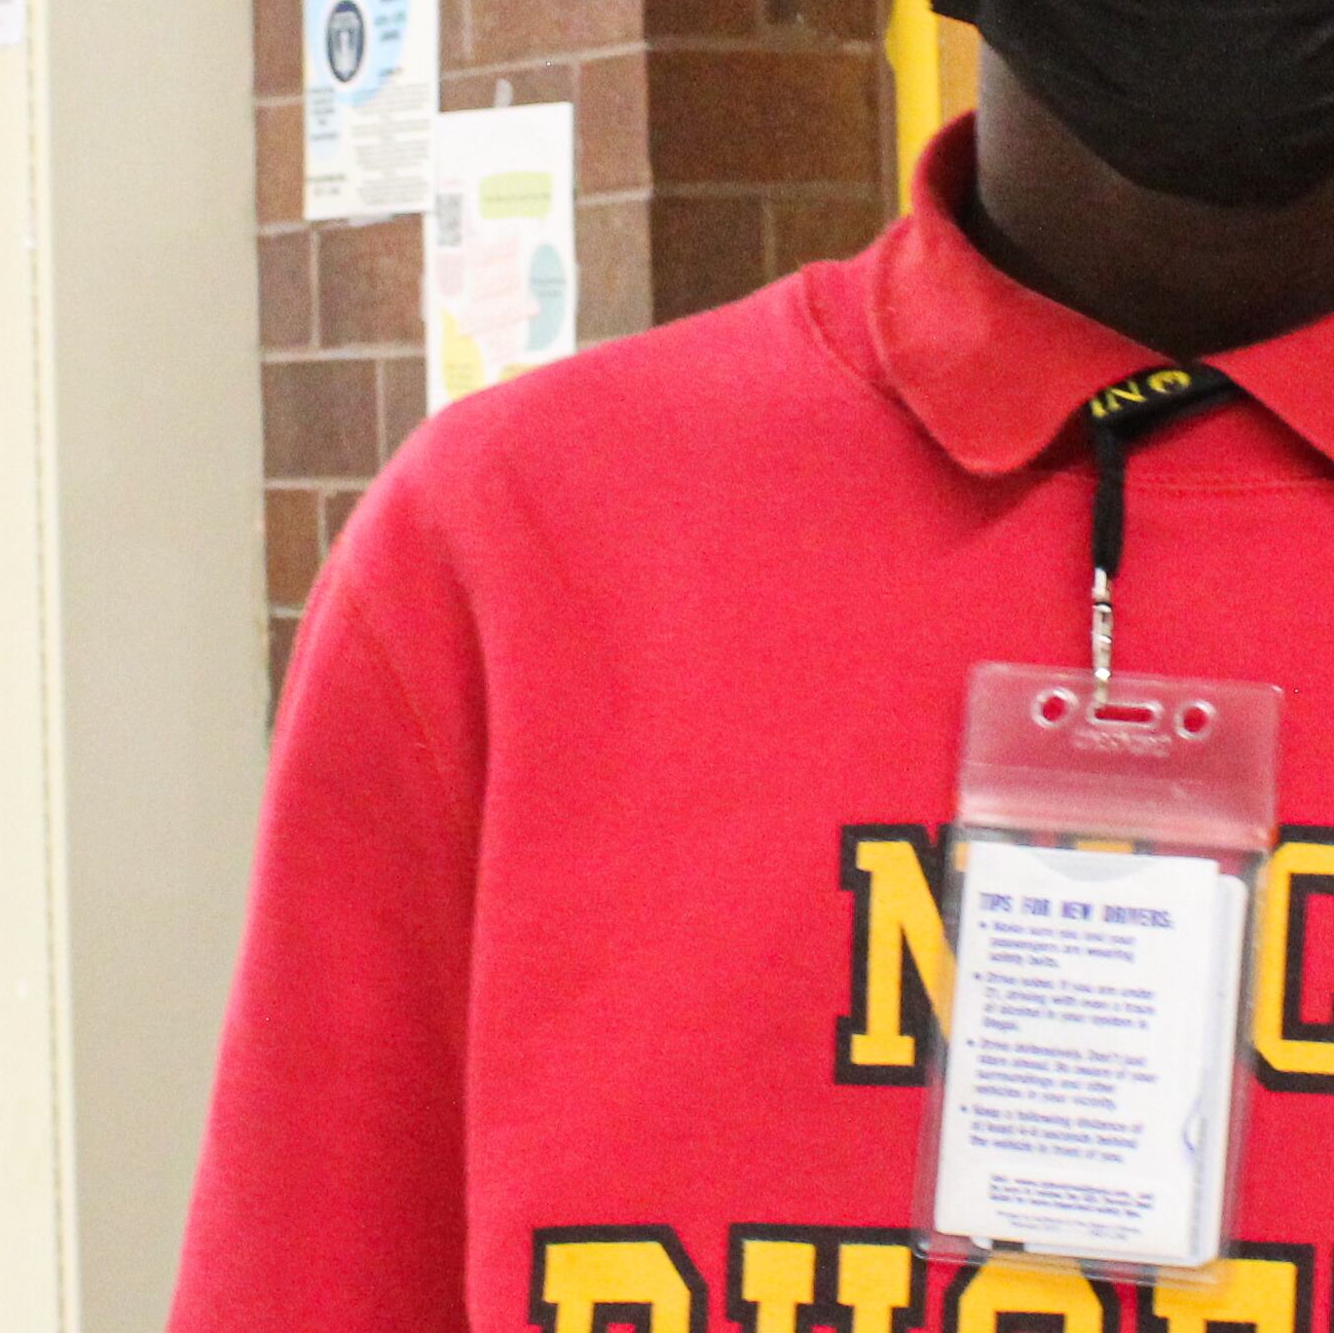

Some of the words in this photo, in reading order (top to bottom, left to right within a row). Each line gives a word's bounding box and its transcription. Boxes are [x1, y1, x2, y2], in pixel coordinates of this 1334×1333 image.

[979, 892, 1014, 913] TIPS
[1021, 897, 1052, 917] FOR
[1061, 901, 1094, 921] NEW
[991, 938, 1059, 953] passengers
[1086, 948, 1134, 962] wearing
